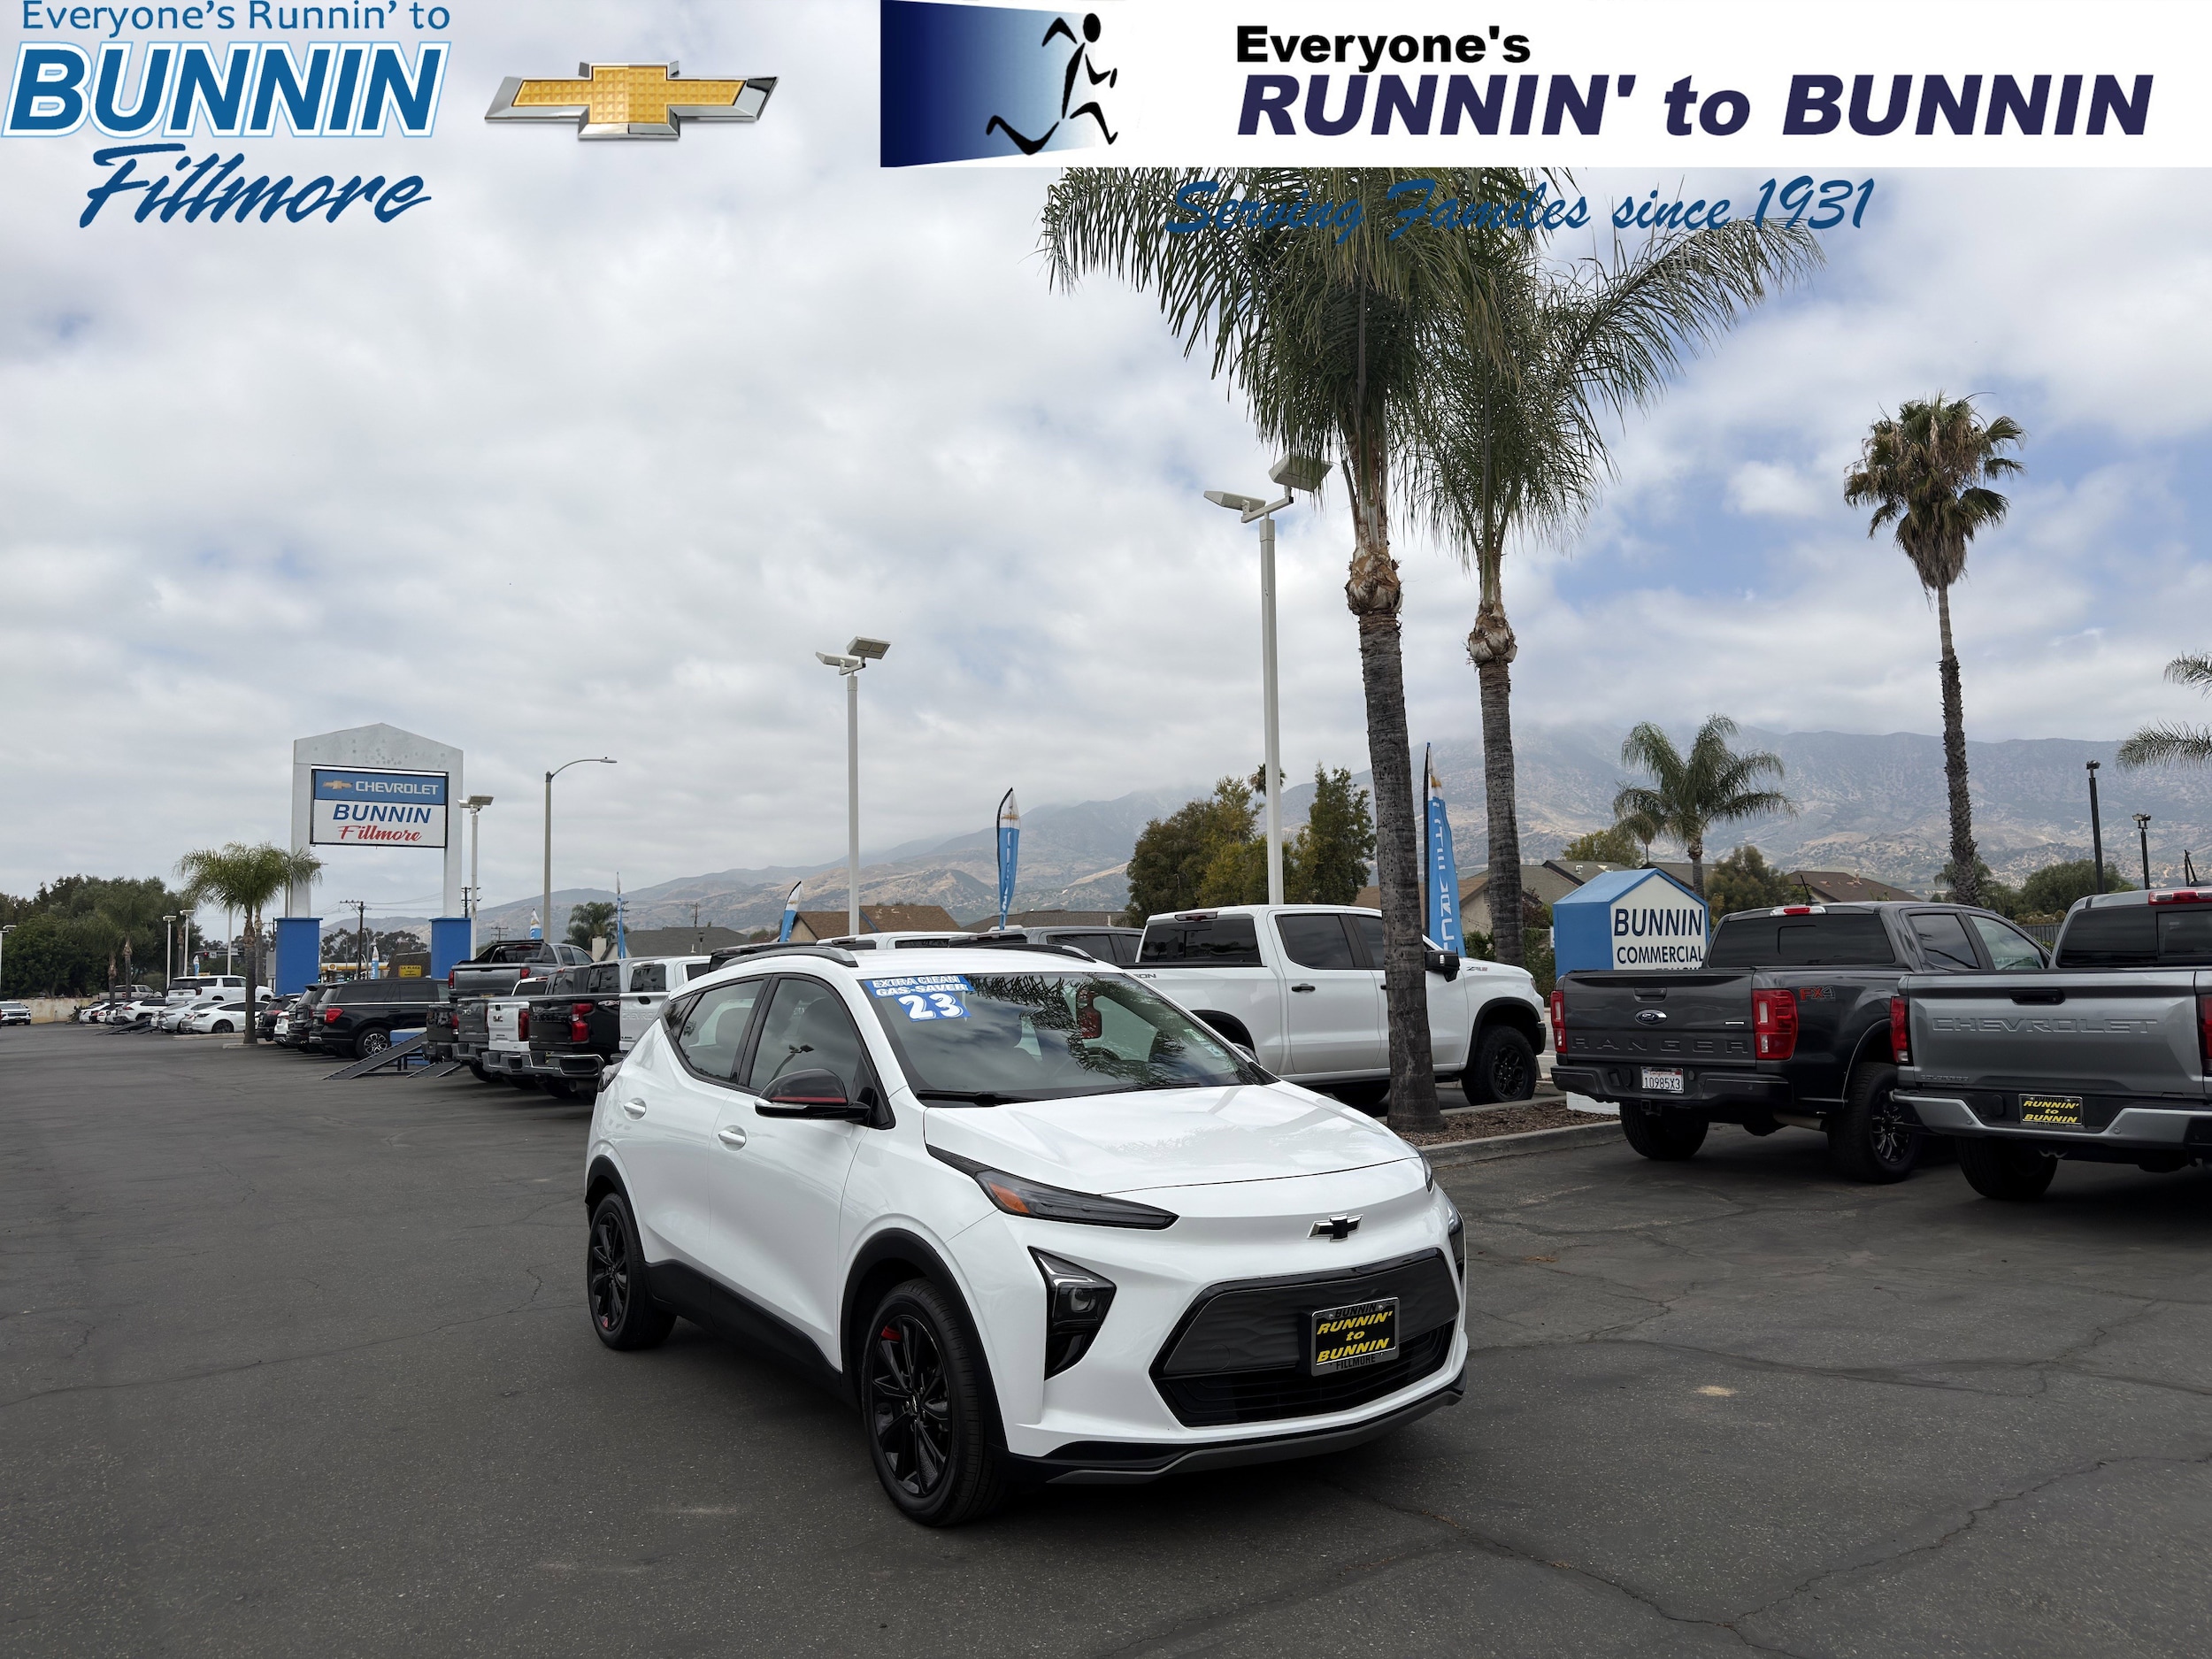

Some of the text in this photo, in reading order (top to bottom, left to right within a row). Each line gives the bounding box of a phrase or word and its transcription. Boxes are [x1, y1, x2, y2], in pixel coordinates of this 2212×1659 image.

[355, 780, 439, 795] CHEVROLET
[333, 803, 432, 824] BUNNIN
[336, 825, 422, 841] Fillmore
[1614, 908, 1702, 937] BUNNIN
[1617, 945, 1704, 964] COMMERCIAL
[872, 975, 960, 988] EXTRA CLEAN
[875, 983, 969, 997] GAS-SAVER
[1798, 986, 1836, 1002] FX4
[898, 993, 964, 1019] 23
[622, 1011, 654, 1020] CHEVRO
[1932, 1018, 2157, 1033] CHEVROLET
[1571, 1037, 1748, 1055] RANGER
[1643, 1077, 1681, 1090] 10985X3
[2023, 1100, 2080, 1110] RUNNIN'
[2024, 1113, 2078, 1124] BUNNIN
[1334, 1303, 1377, 1318] BUNNIN
[1316, 1310, 1394, 1335] RUNNIN'
[1346, 1330, 1365, 1341] to
[1316, 1337, 1390, 1363] BUNNIN
[1336, 1354, 1376, 1371] FILLMORE
